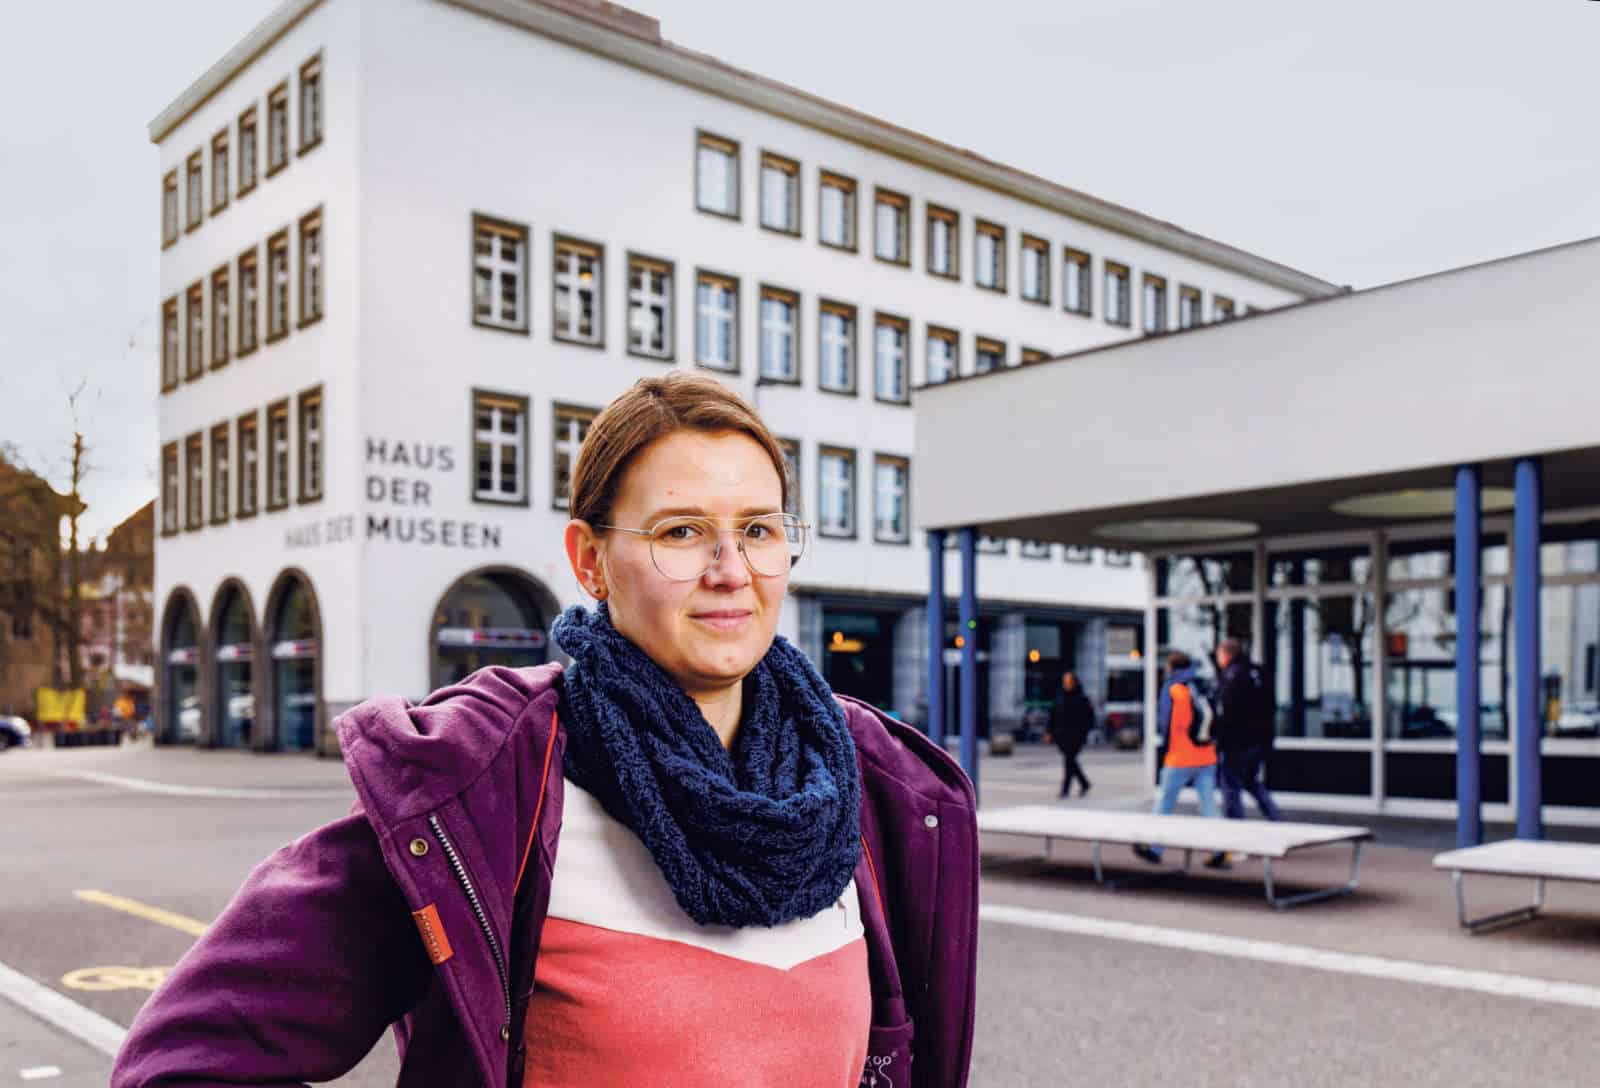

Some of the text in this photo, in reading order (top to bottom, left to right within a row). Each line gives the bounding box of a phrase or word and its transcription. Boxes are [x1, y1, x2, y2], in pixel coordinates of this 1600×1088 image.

[366, 437, 454, 471] HAUS
[366, 476, 431, 505] DER
[366, 515, 502, 548] MUSEEN
